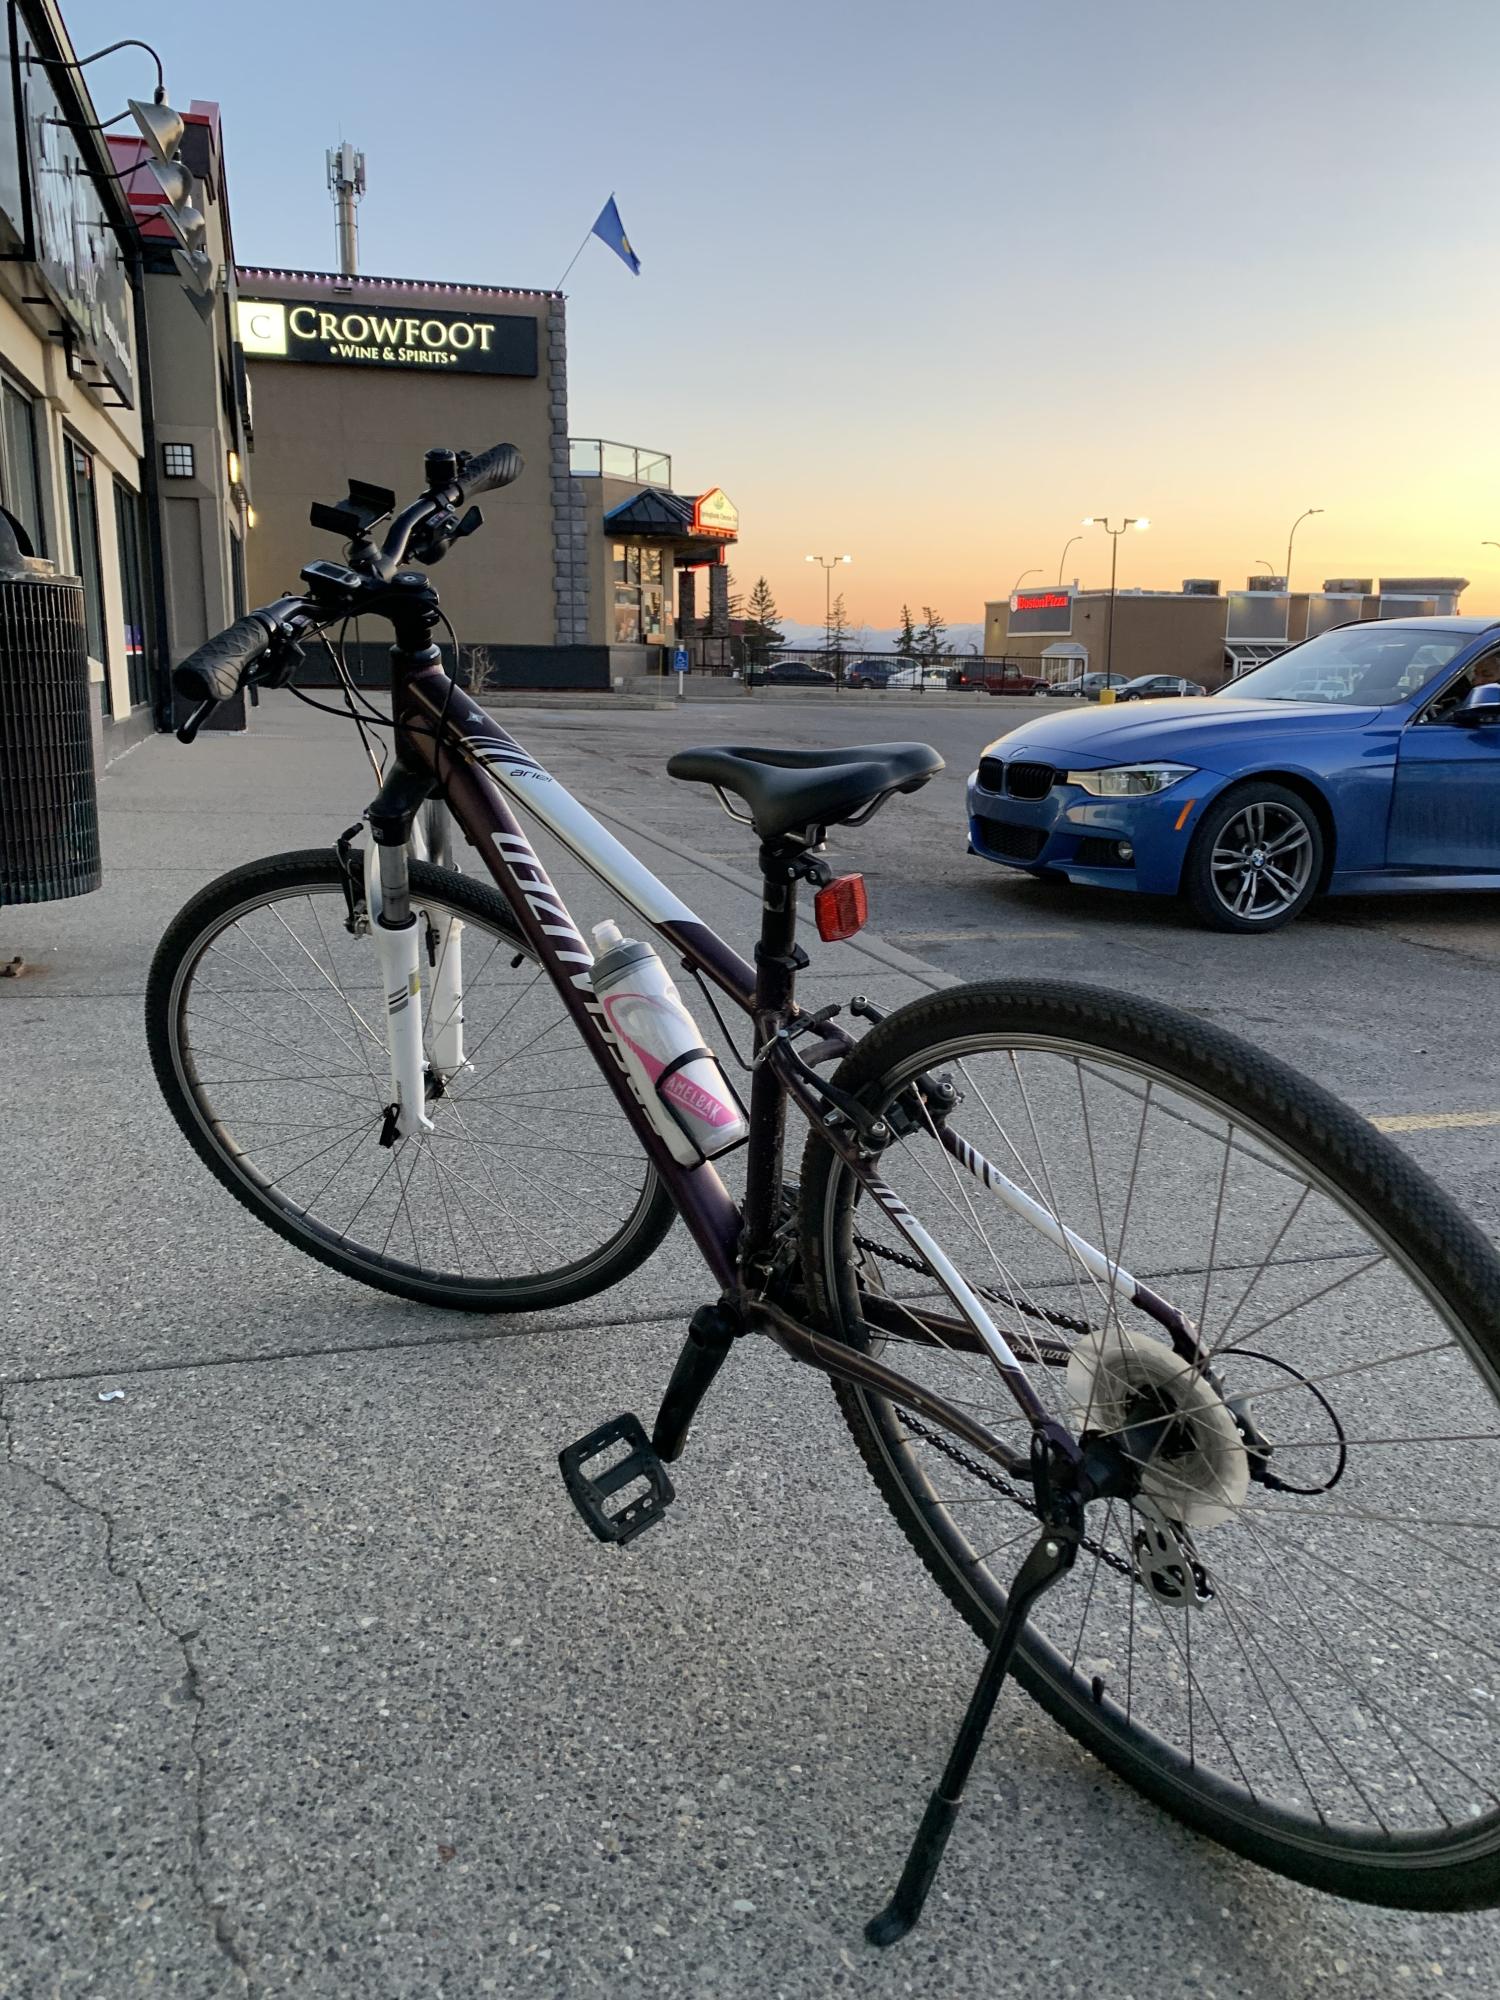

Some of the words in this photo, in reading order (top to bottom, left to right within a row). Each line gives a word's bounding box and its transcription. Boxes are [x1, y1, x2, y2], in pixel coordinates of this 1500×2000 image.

[289, 307, 495, 350] CROWFOOT
[382, 346, 396, 361] &
[664, 1076, 723, 1122] AMELBAK
